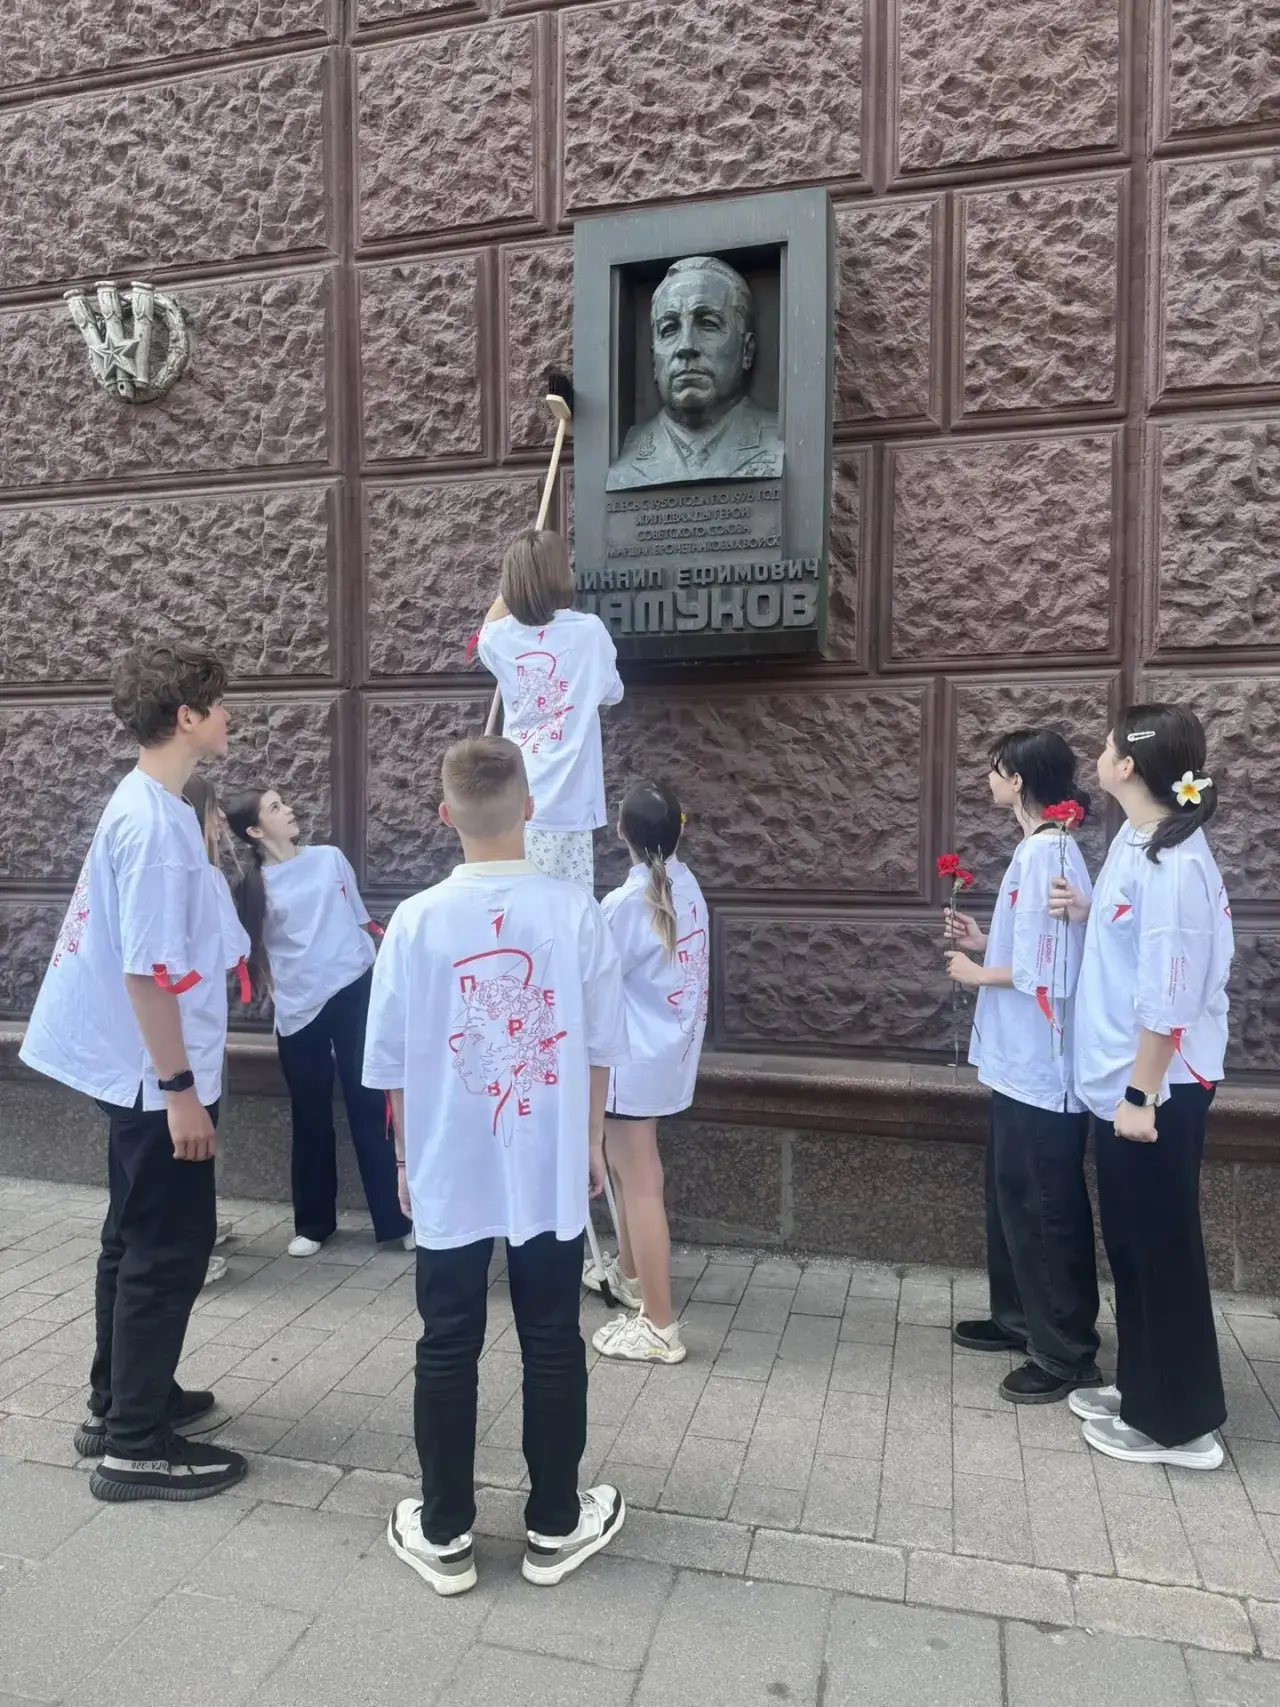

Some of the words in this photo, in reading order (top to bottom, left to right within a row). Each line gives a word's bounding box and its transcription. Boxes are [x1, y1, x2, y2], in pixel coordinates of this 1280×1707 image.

[607, 501, 640, 513] ЗДЕСЬ
[680, 495, 709, 508] ГОДА
[712, 493, 728, 506] ПО
[760, 488, 780, 501] ГОД
[636, 511, 662, 526] ЖИЛ
[664, 510, 711, 525] ДВАЖДЫ
[638, 527, 705, 541] СОВЕТСКОГО
[707, 523, 751, 537] СОЮЗА
[607, 544, 653, 558] МАРШАЛ
[654, 540, 743, 556] БРОНЕТАНКОВЫХ
[676, 558, 820, 588] ЕФИМОВИЧ
